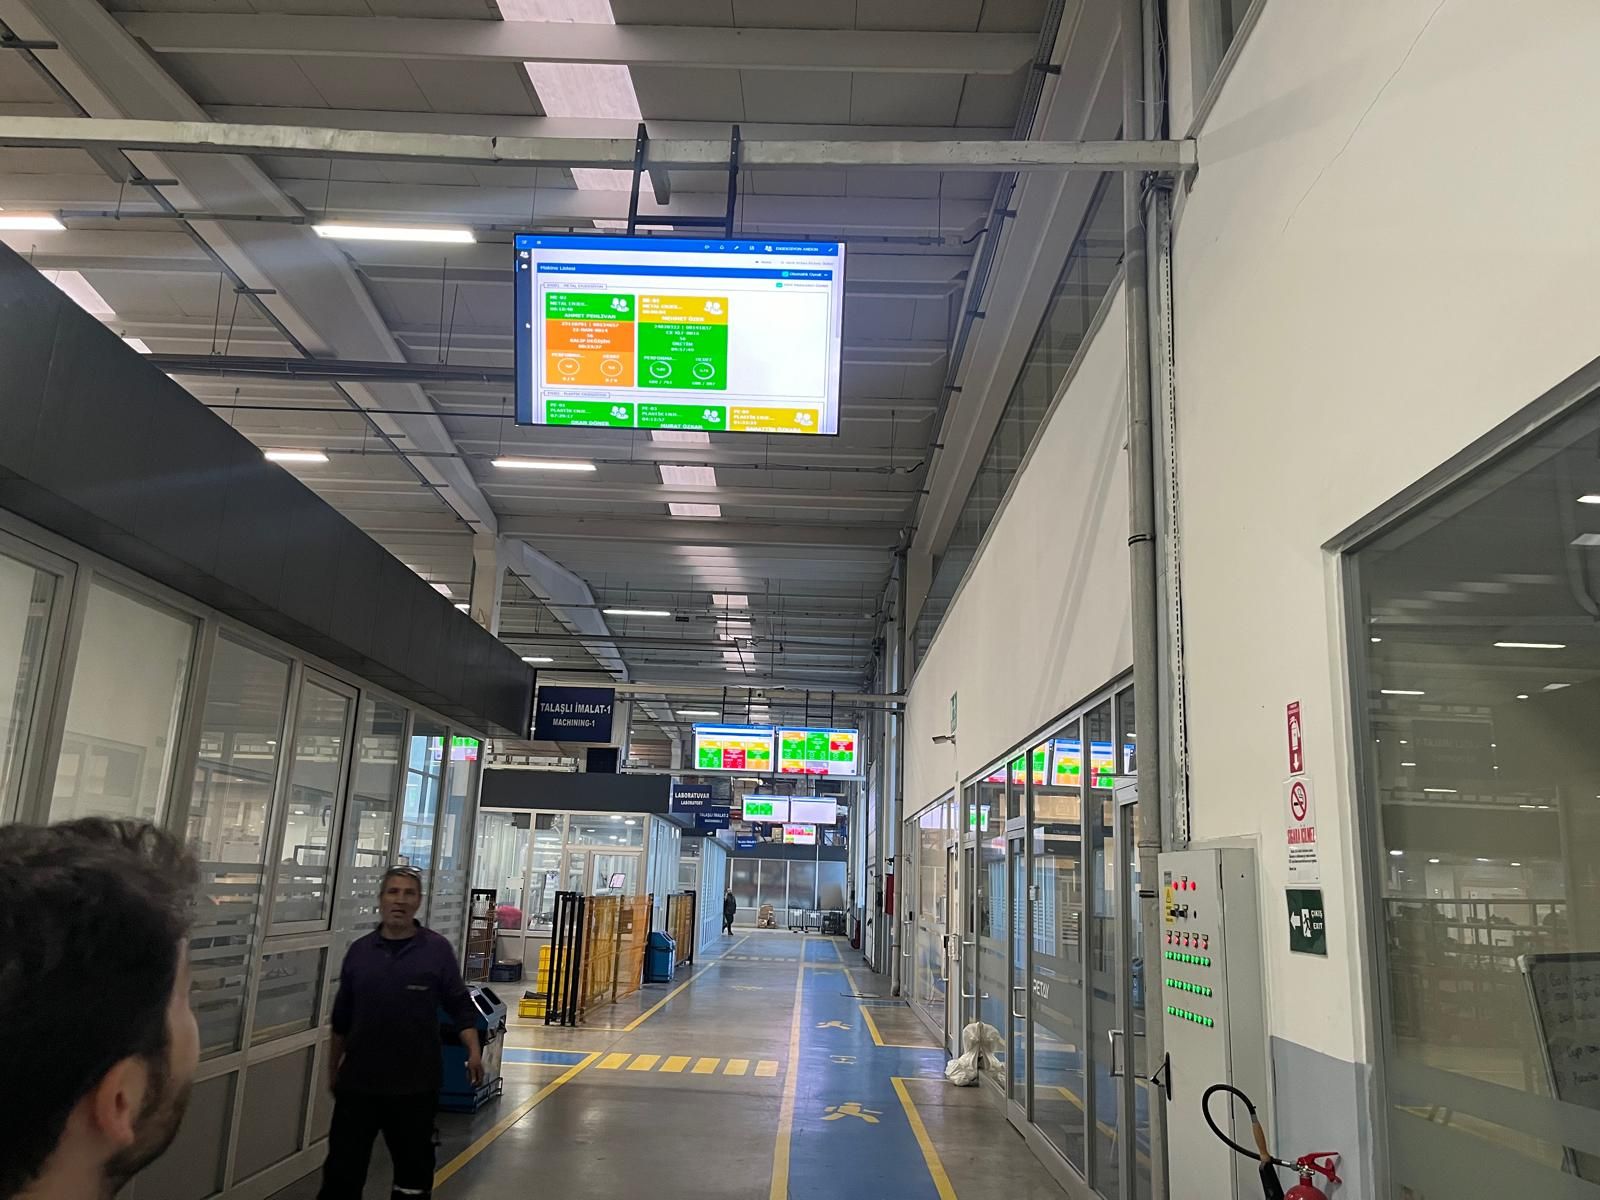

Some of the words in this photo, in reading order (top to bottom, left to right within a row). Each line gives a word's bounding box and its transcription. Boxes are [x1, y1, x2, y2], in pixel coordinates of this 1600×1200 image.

[540, 702, 573, 714] TALAŞLI
[575, 702, 611, 714] İMALAT-1
[552, 718, 596, 727] MACHINING-1
[1310, 910, 1322, 919] ÇIKIŞ
